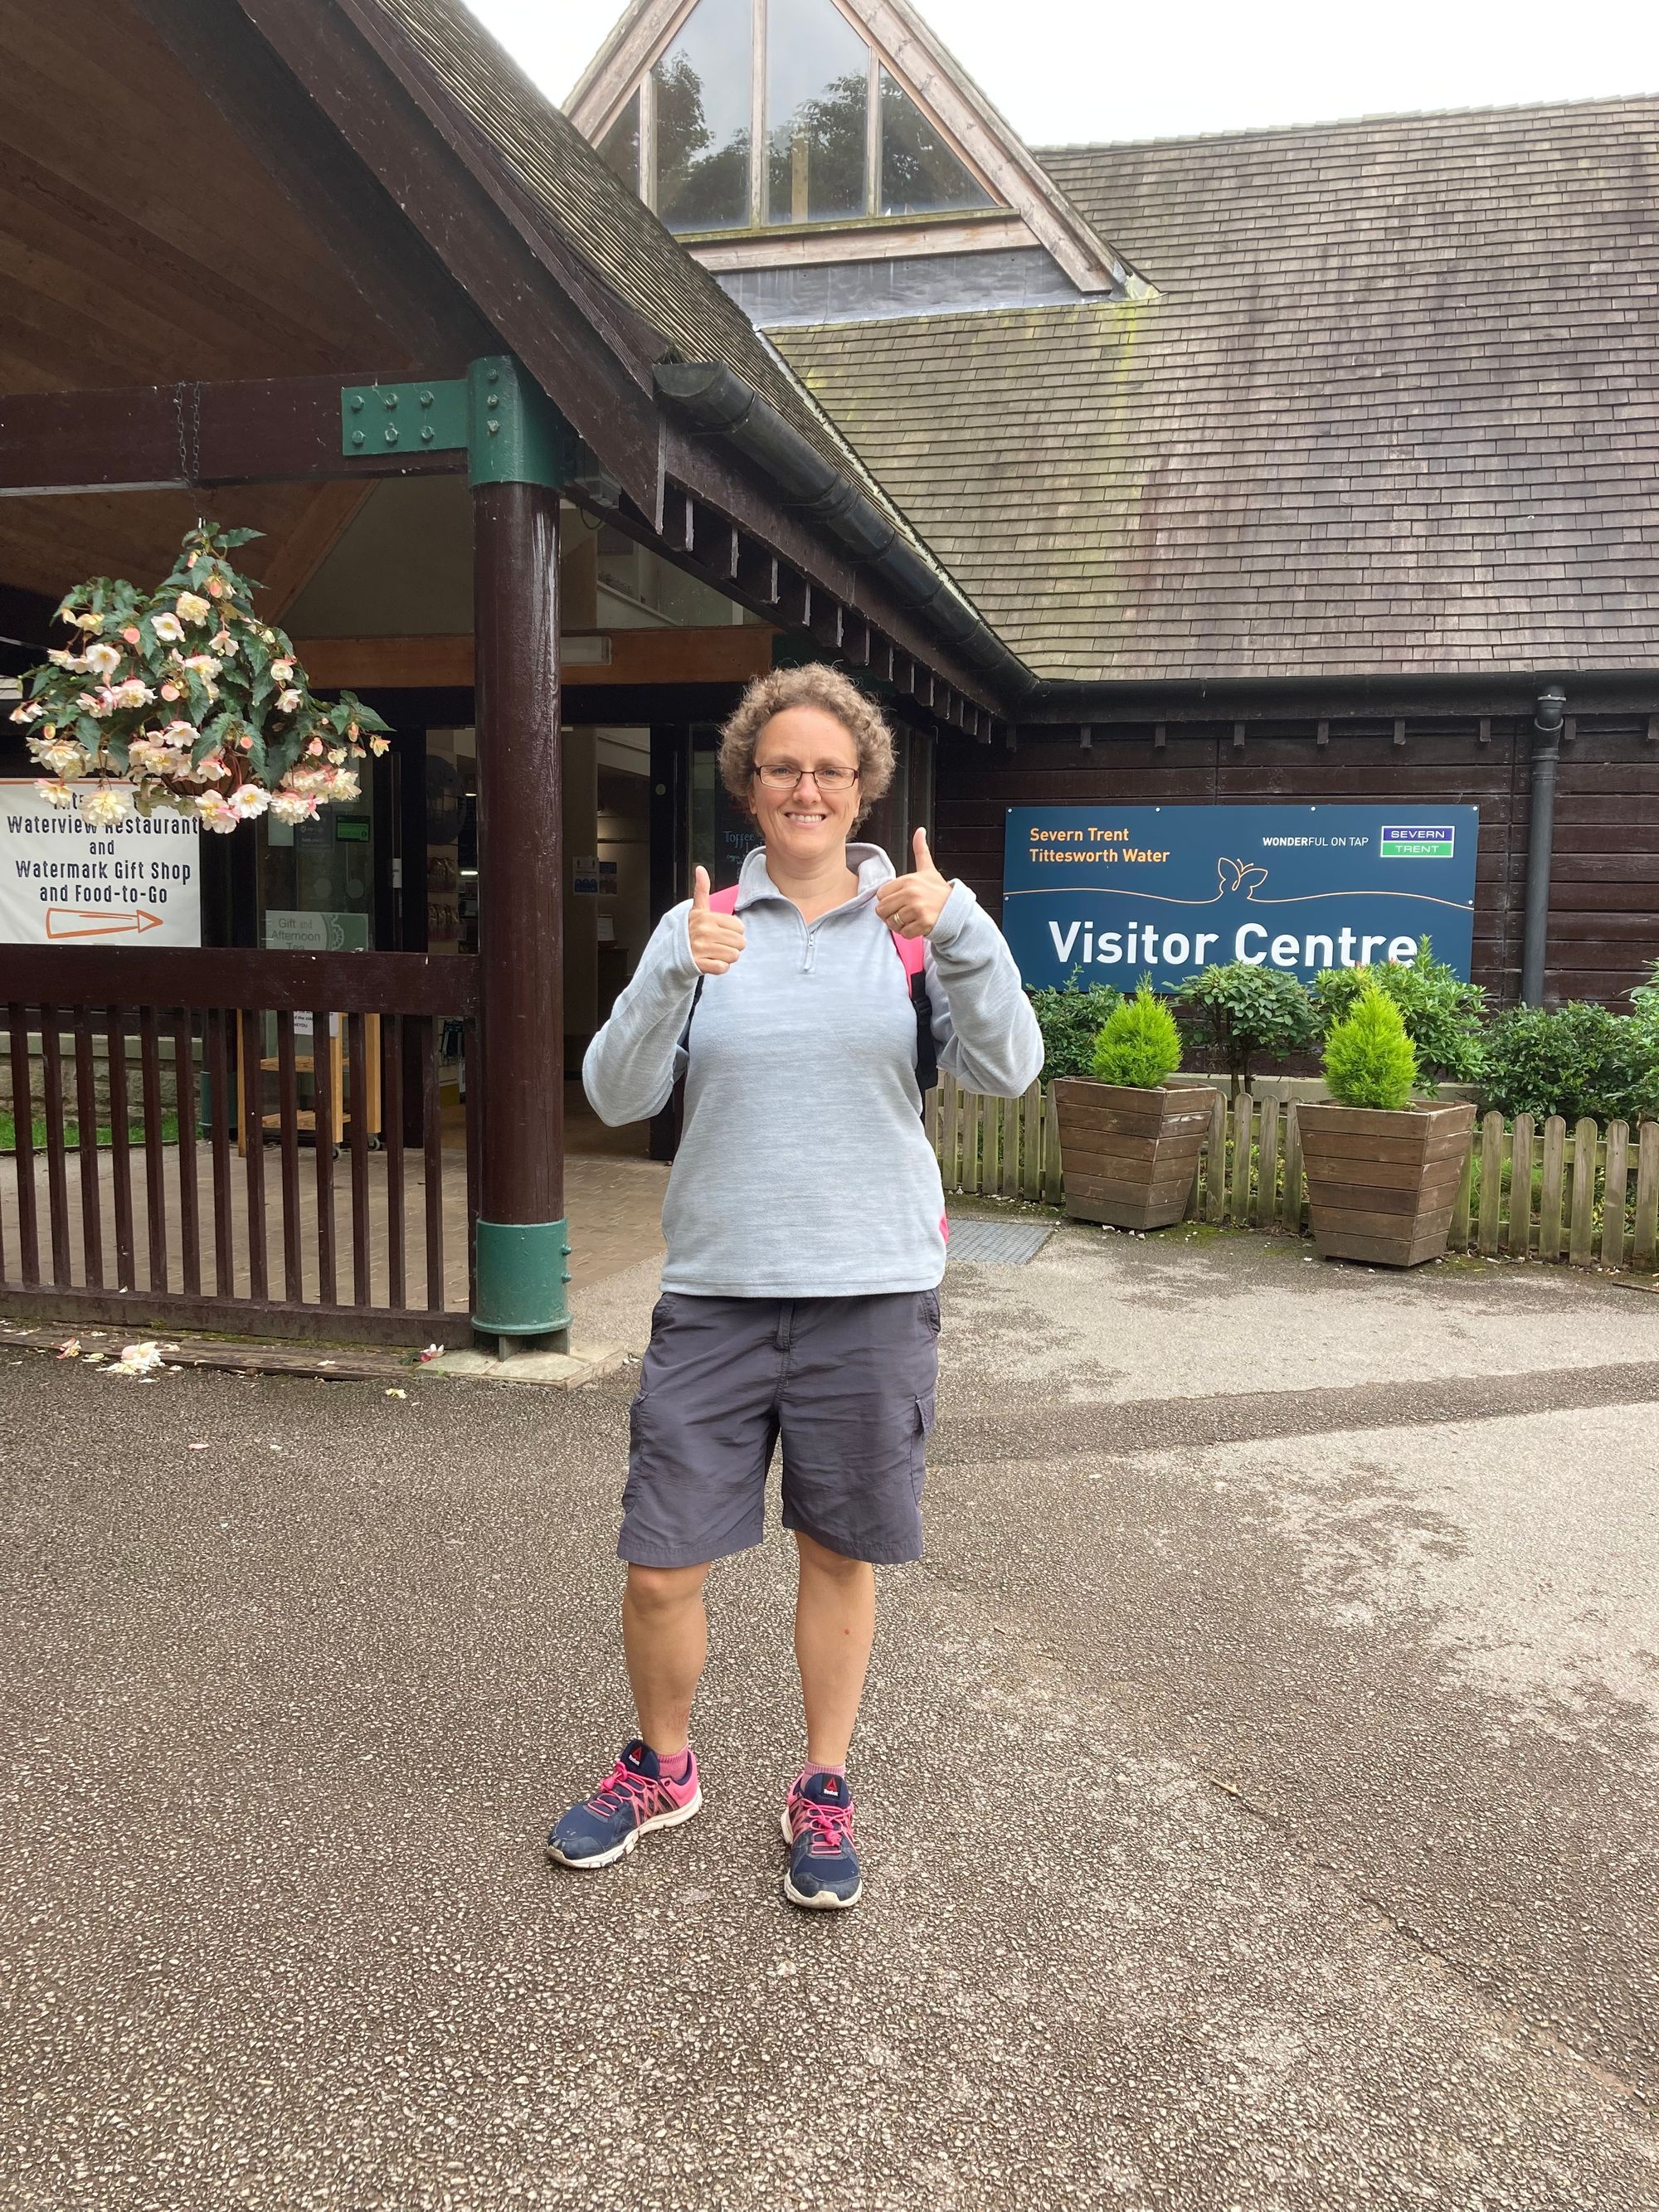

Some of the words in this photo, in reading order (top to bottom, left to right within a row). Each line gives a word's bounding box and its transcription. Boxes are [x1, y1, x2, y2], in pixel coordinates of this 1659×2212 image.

[7, 814, 97, 834] Waterview
[1029, 827, 1083, 842] Severn
[1087, 827, 1129, 842] Trent
[1262, 836, 1329, 847] WONDERFUL
[1331, 836, 1346, 847] ON
[1350, 837, 1369, 847] TAP
[1390, 830, 1445, 839] SEVERN
[89, 839, 114, 855] and
[1395, 844, 1439, 853] TRENT
[1029, 848, 1118, 863] Tittesworth
[1122, 848, 1170, 863] Water
[16, 860, 108, 879] Watermark
[114, 860, 144, 880] Gift
[151, 861, 191, 886] Shop
[40, 884, 68, 902] and
[75, 884, 168, 903] Food-to-Go
[278, 917, 295, 929] Gift
[299, 919, 312, 930] and
[272, 930, 321, 941] Afternoon
[1048, 920, 1219, 965] Visitor
[1235, 922, 1418, 969] Centre
